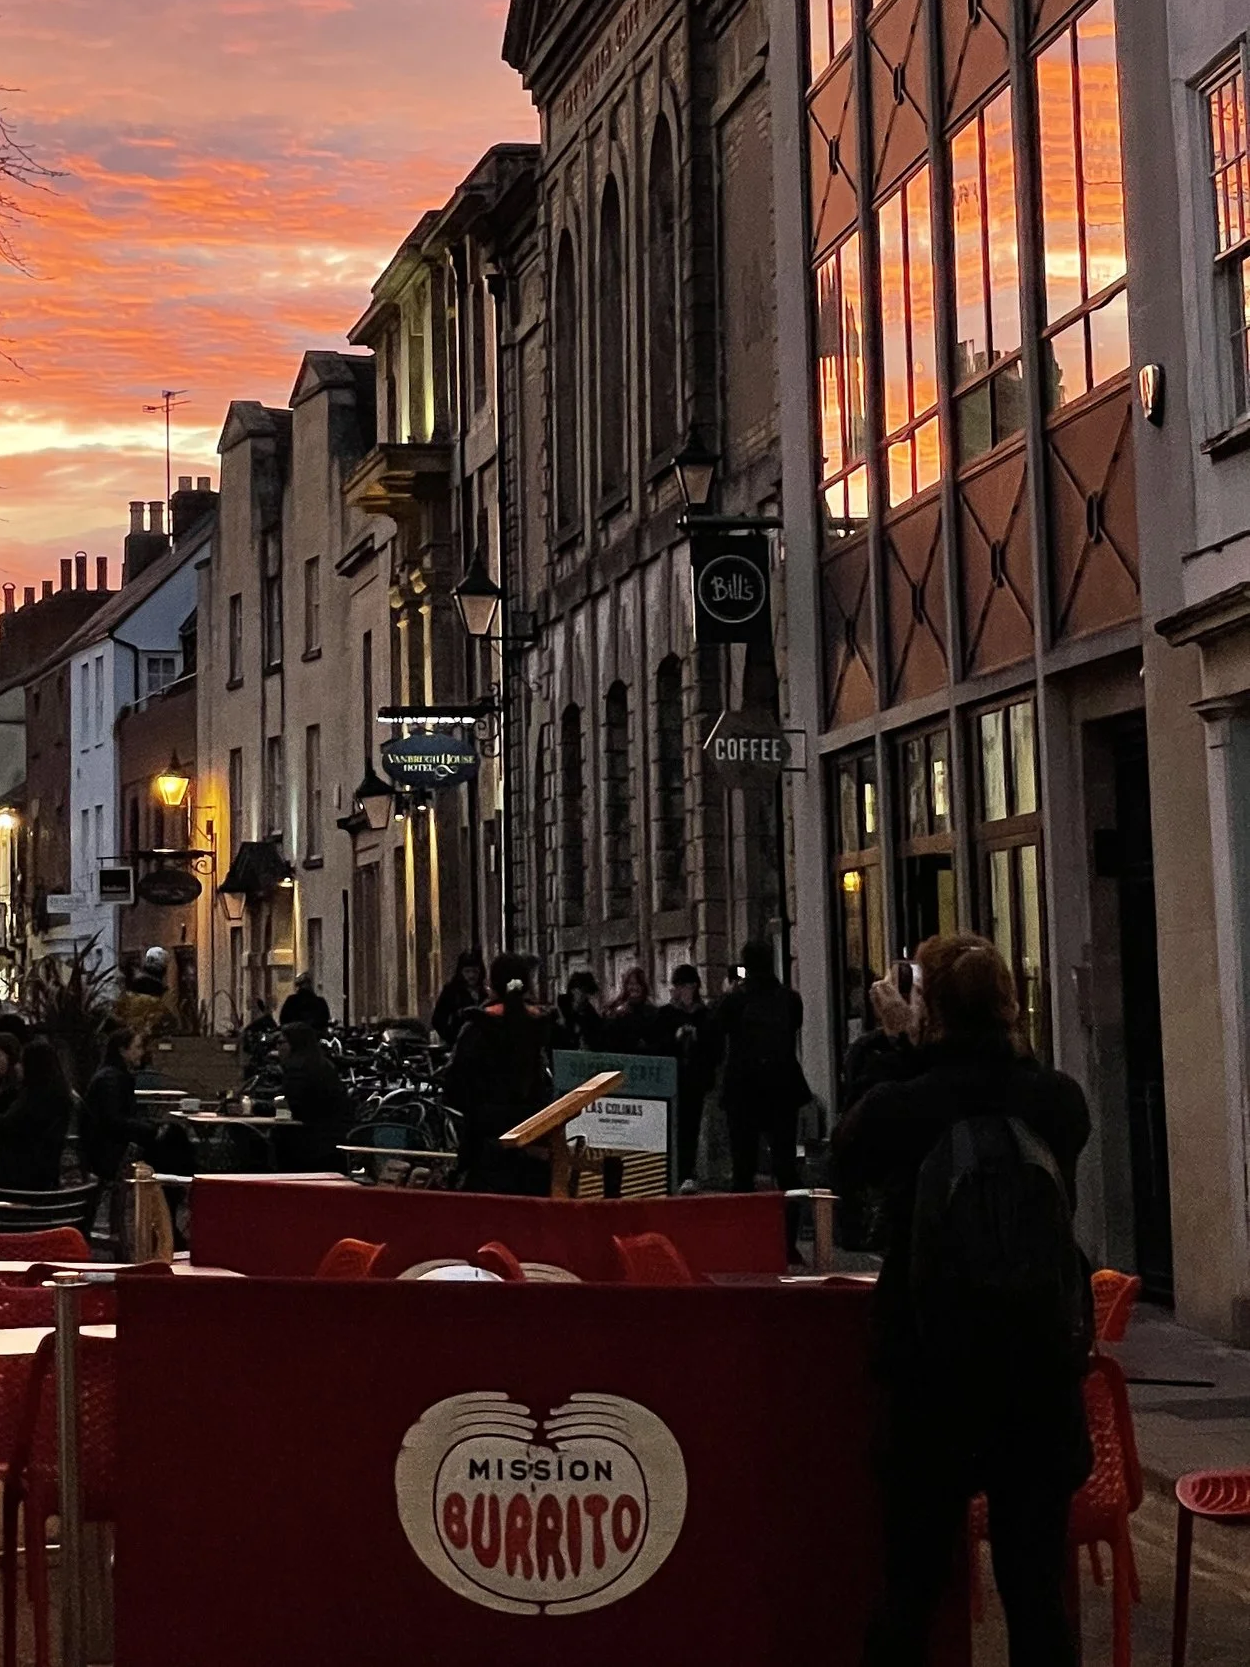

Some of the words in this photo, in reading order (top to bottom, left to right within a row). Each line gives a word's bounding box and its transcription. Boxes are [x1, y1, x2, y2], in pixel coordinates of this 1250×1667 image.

[710, 573, 754, 602] Bill's
[715, 738, 782, 761] COFFEE
[403, 764, 434, 772] HOTEL
[468, 1458, 612, 1482] MISSION
[443, 1492, 641, 1582] BURRITO
